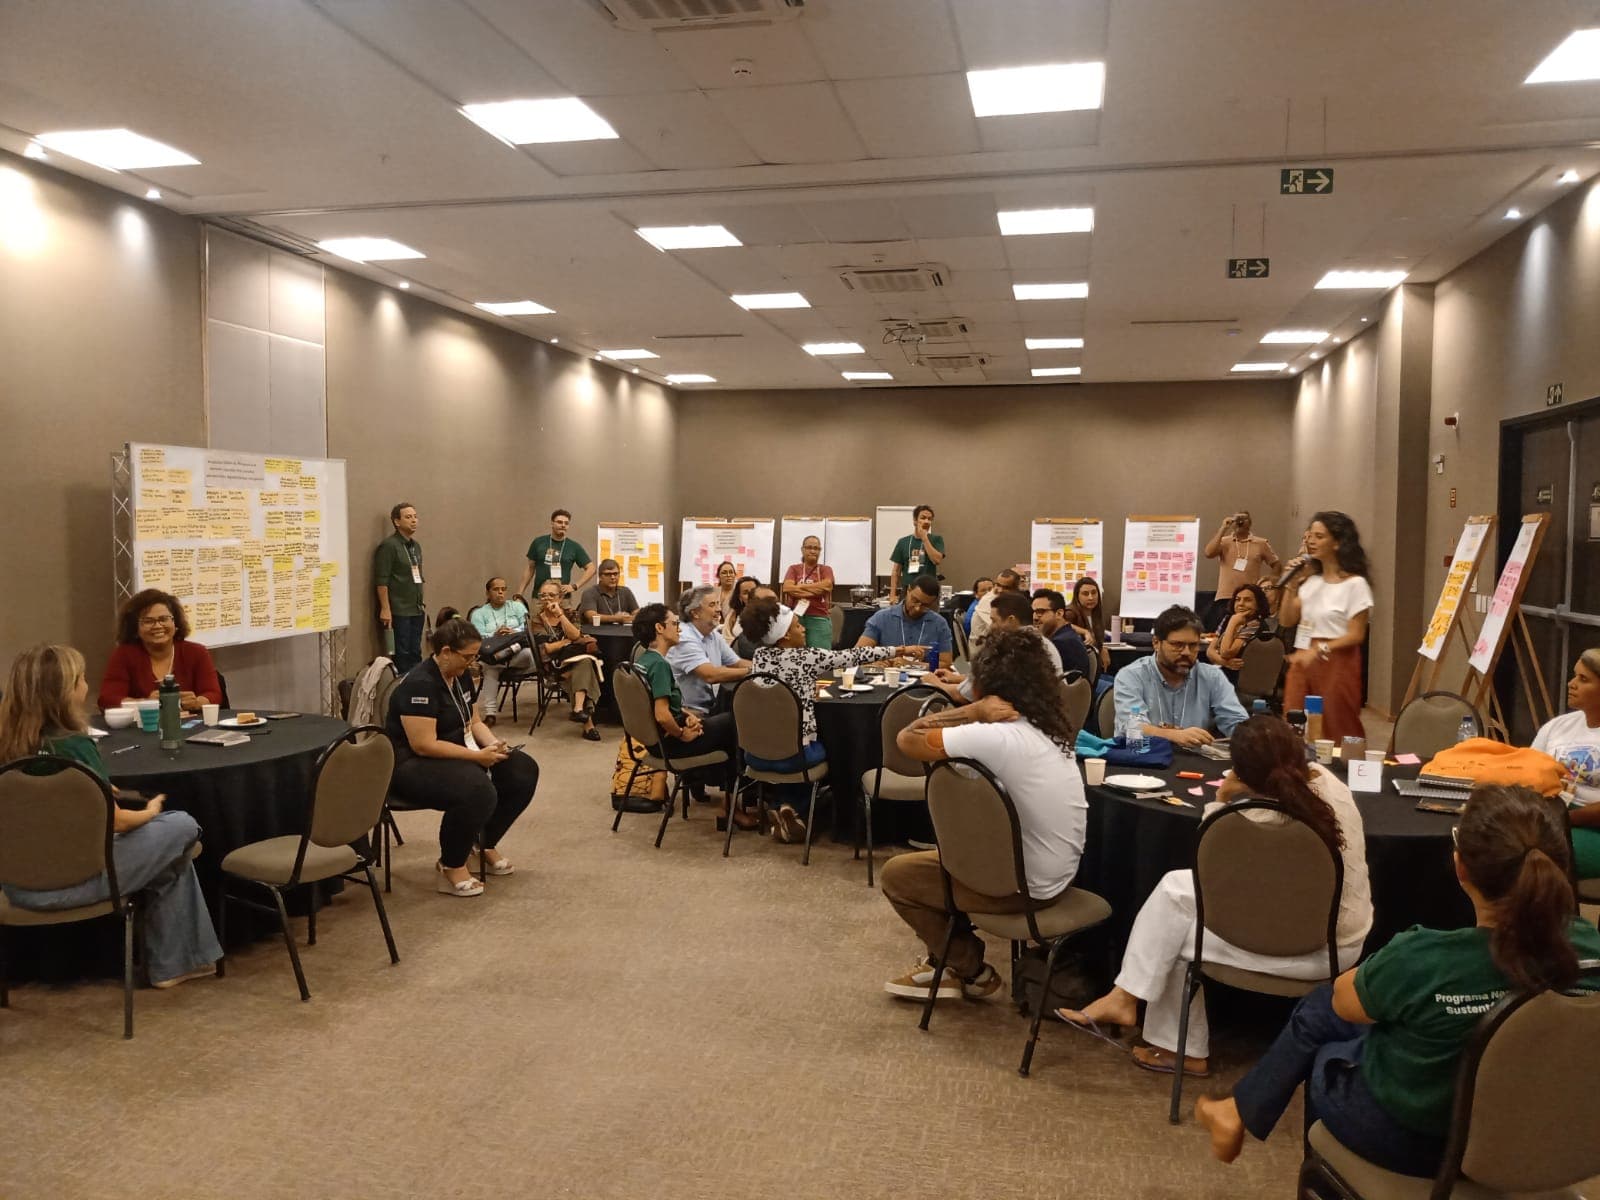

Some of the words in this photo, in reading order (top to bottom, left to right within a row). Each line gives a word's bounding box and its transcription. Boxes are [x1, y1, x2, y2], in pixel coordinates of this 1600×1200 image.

[1357, 764, 1368, 777] E
[1434, 993, 1489, 1005] Programa
[1445, 1001, 1495, 1015] Sustent
